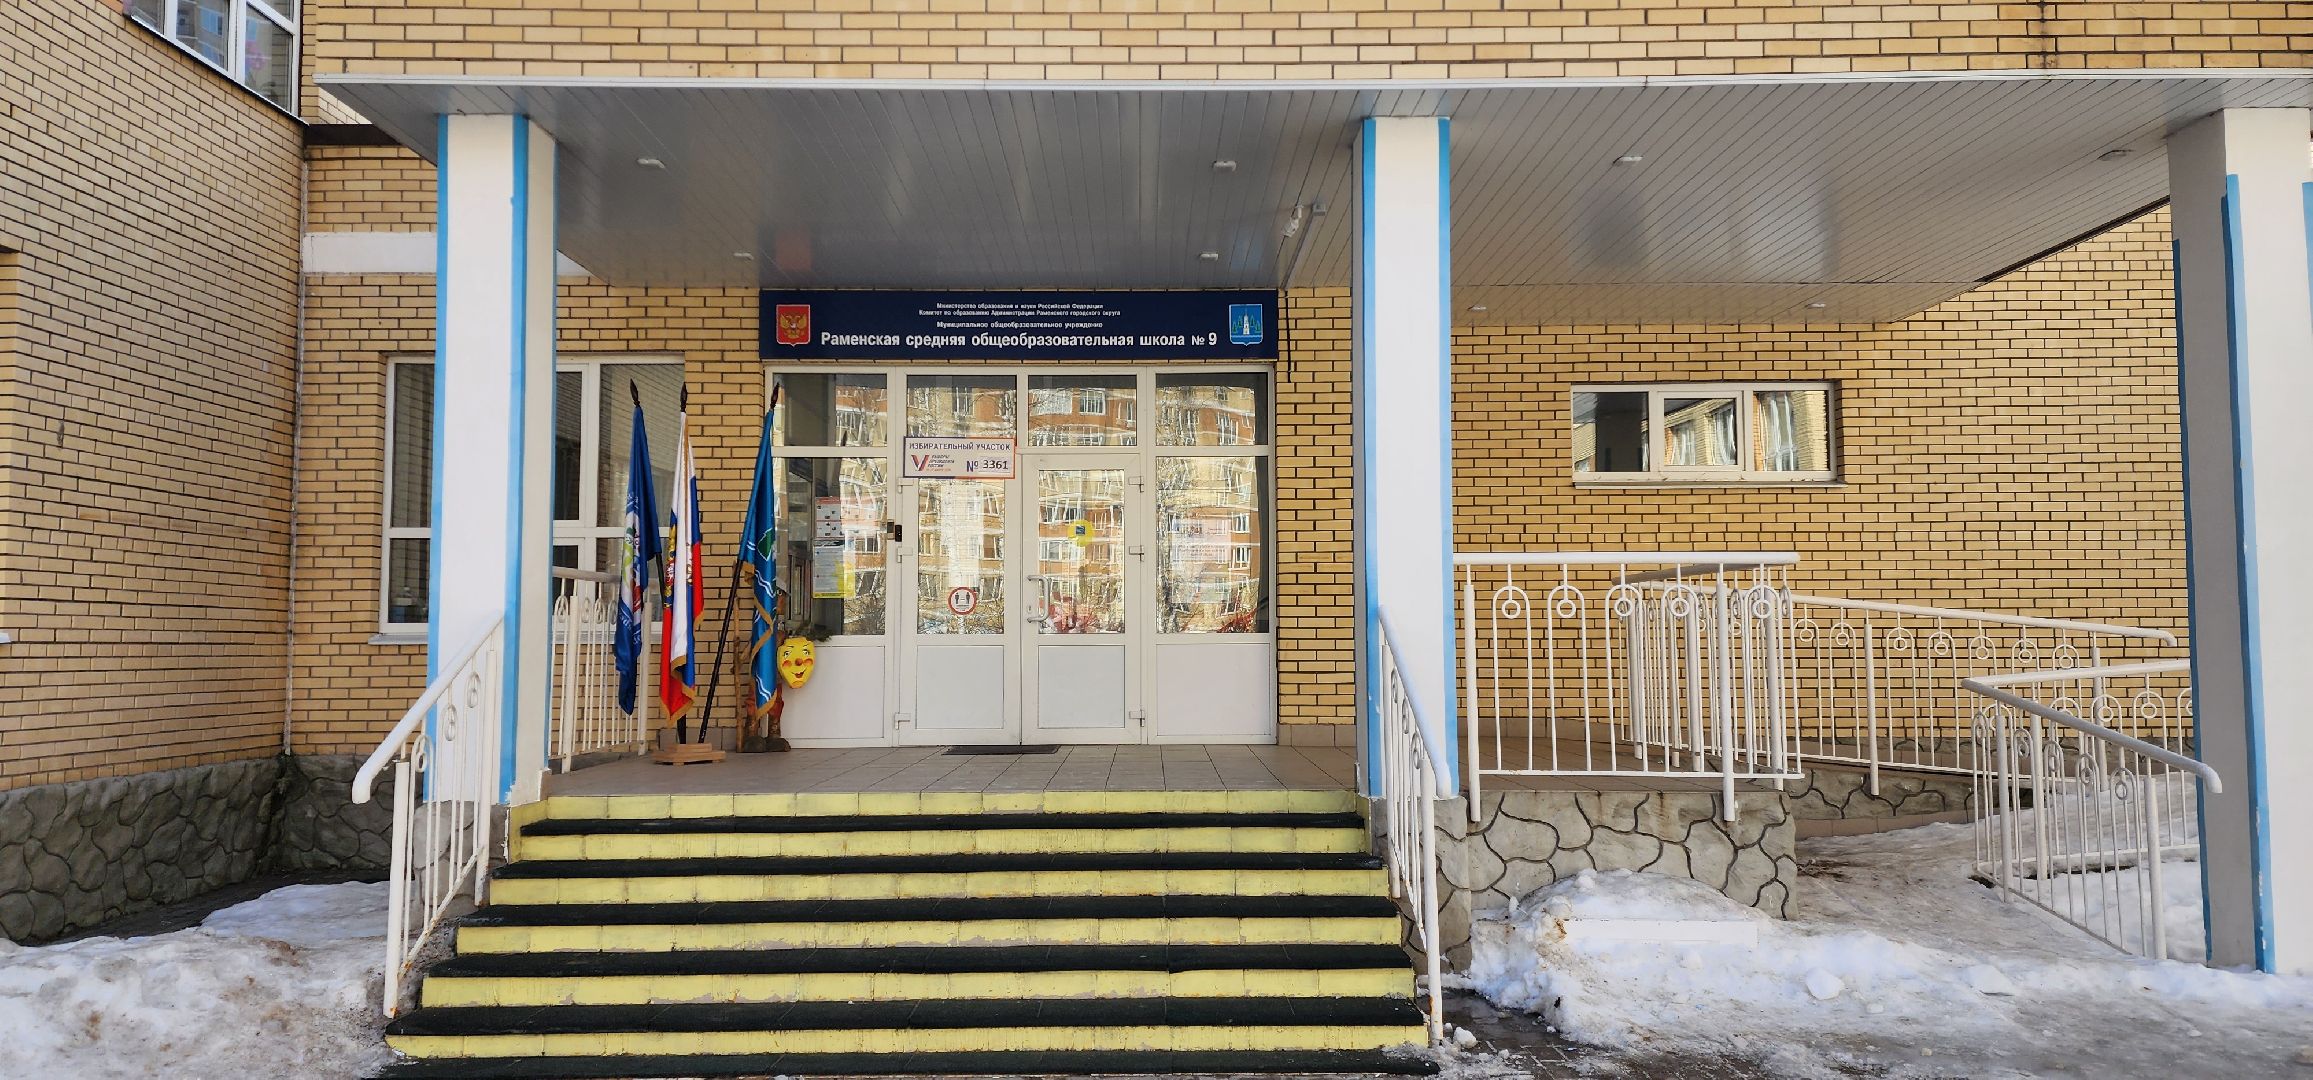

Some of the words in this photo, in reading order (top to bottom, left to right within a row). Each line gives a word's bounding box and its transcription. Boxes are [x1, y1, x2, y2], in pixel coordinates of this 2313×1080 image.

[820, 332, 900, 346] Раменская
[905, 334, 966, 348] средняя
[971, 332, 1134, 348] общеобразовательная
[1139, 335, 1185, 346] школа
[1191, 335, 1205, 345] №
[1208, 332, 1218, 346] 9
[909, 442, 974, 450] ИЗБИРАТЕЛЬНЫЙ
[966, 460, 979, 472] №
[982, 460, 1009, 470] 3361
